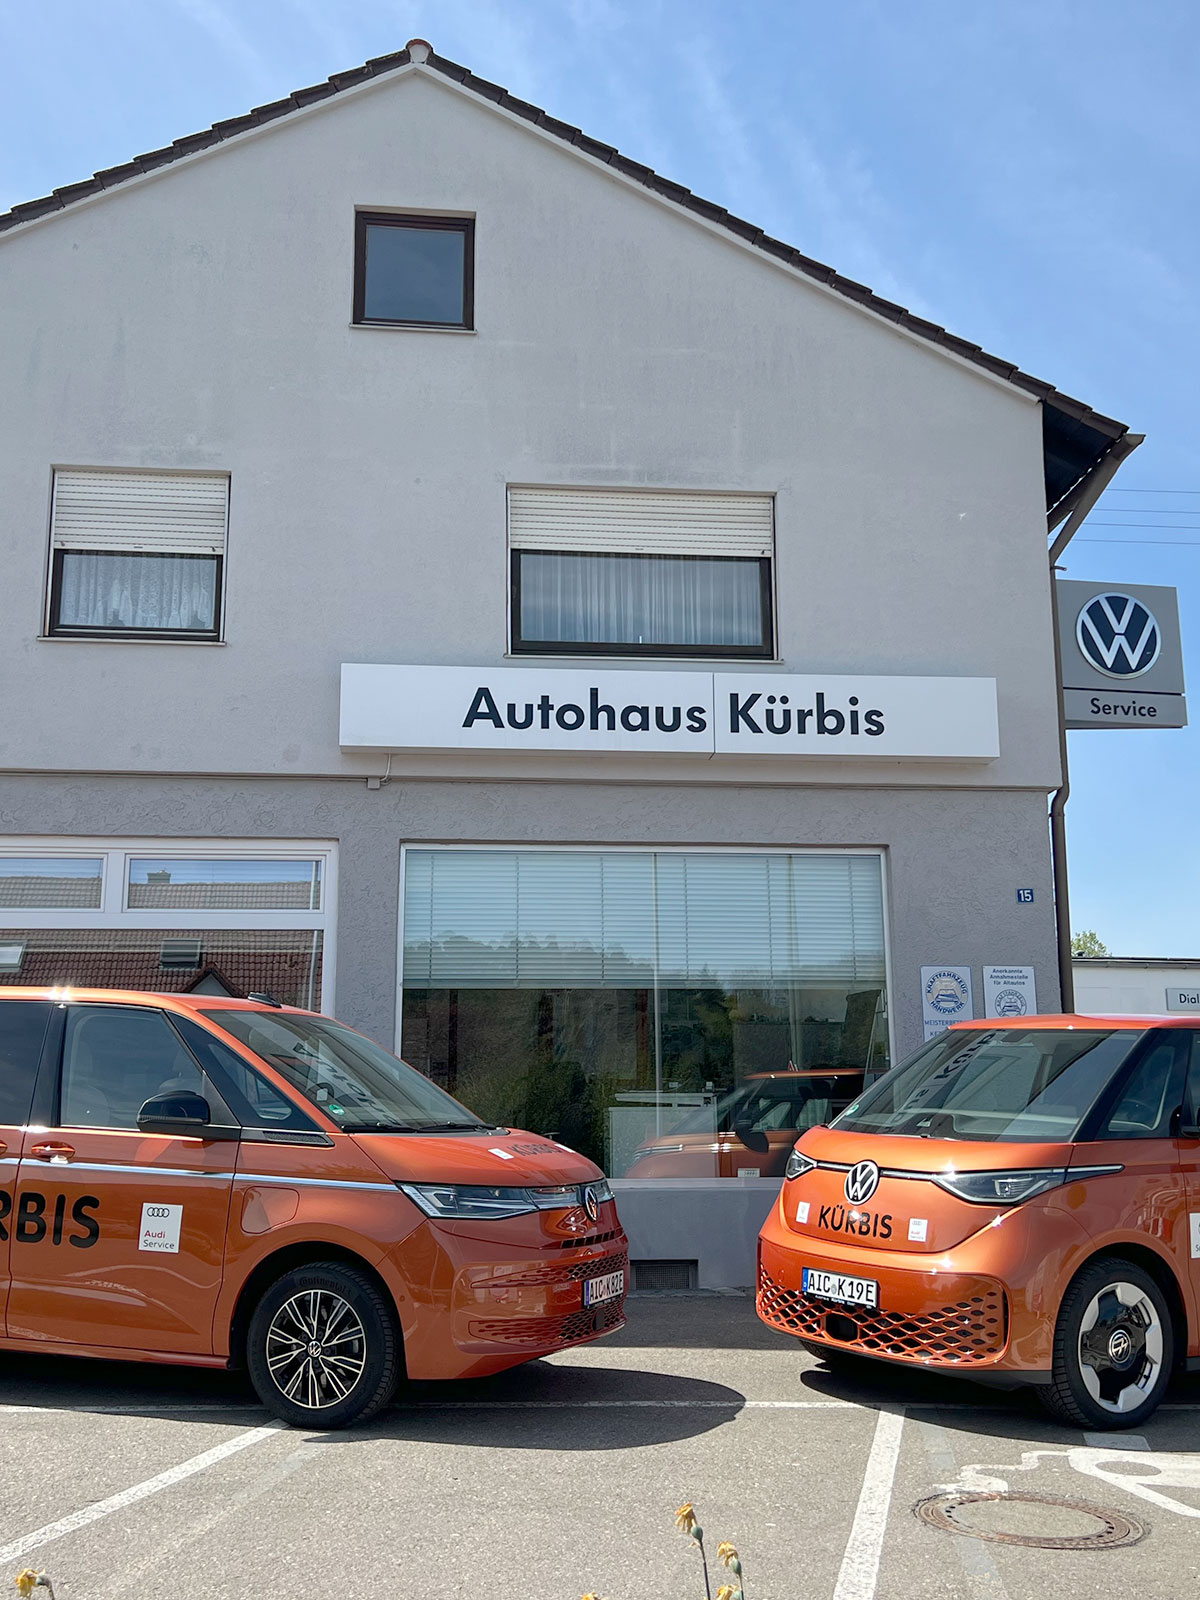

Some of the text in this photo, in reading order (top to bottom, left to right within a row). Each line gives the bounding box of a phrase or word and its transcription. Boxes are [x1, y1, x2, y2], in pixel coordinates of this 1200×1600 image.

[462, 687, 885, 736] Autohaus Kürbis
[1090, 698, 1157, 717] Service
[1019, 890, 1032, 902] 15
[926, 972, 967, 994] KRAFTFAHRZEUG
[1179, 993, 1200, 1004] Dial
[930, 1000, 965, 1014] HANDWERK
[818, 1204, 892, 1239] KÜRBIS
[144, 1230, 166, 1239] Audi
[143, 1239, 175, 1250] Service
[808, 1272, 831, 1294] AIC
[837, 1277, 875, 1303] K19E
